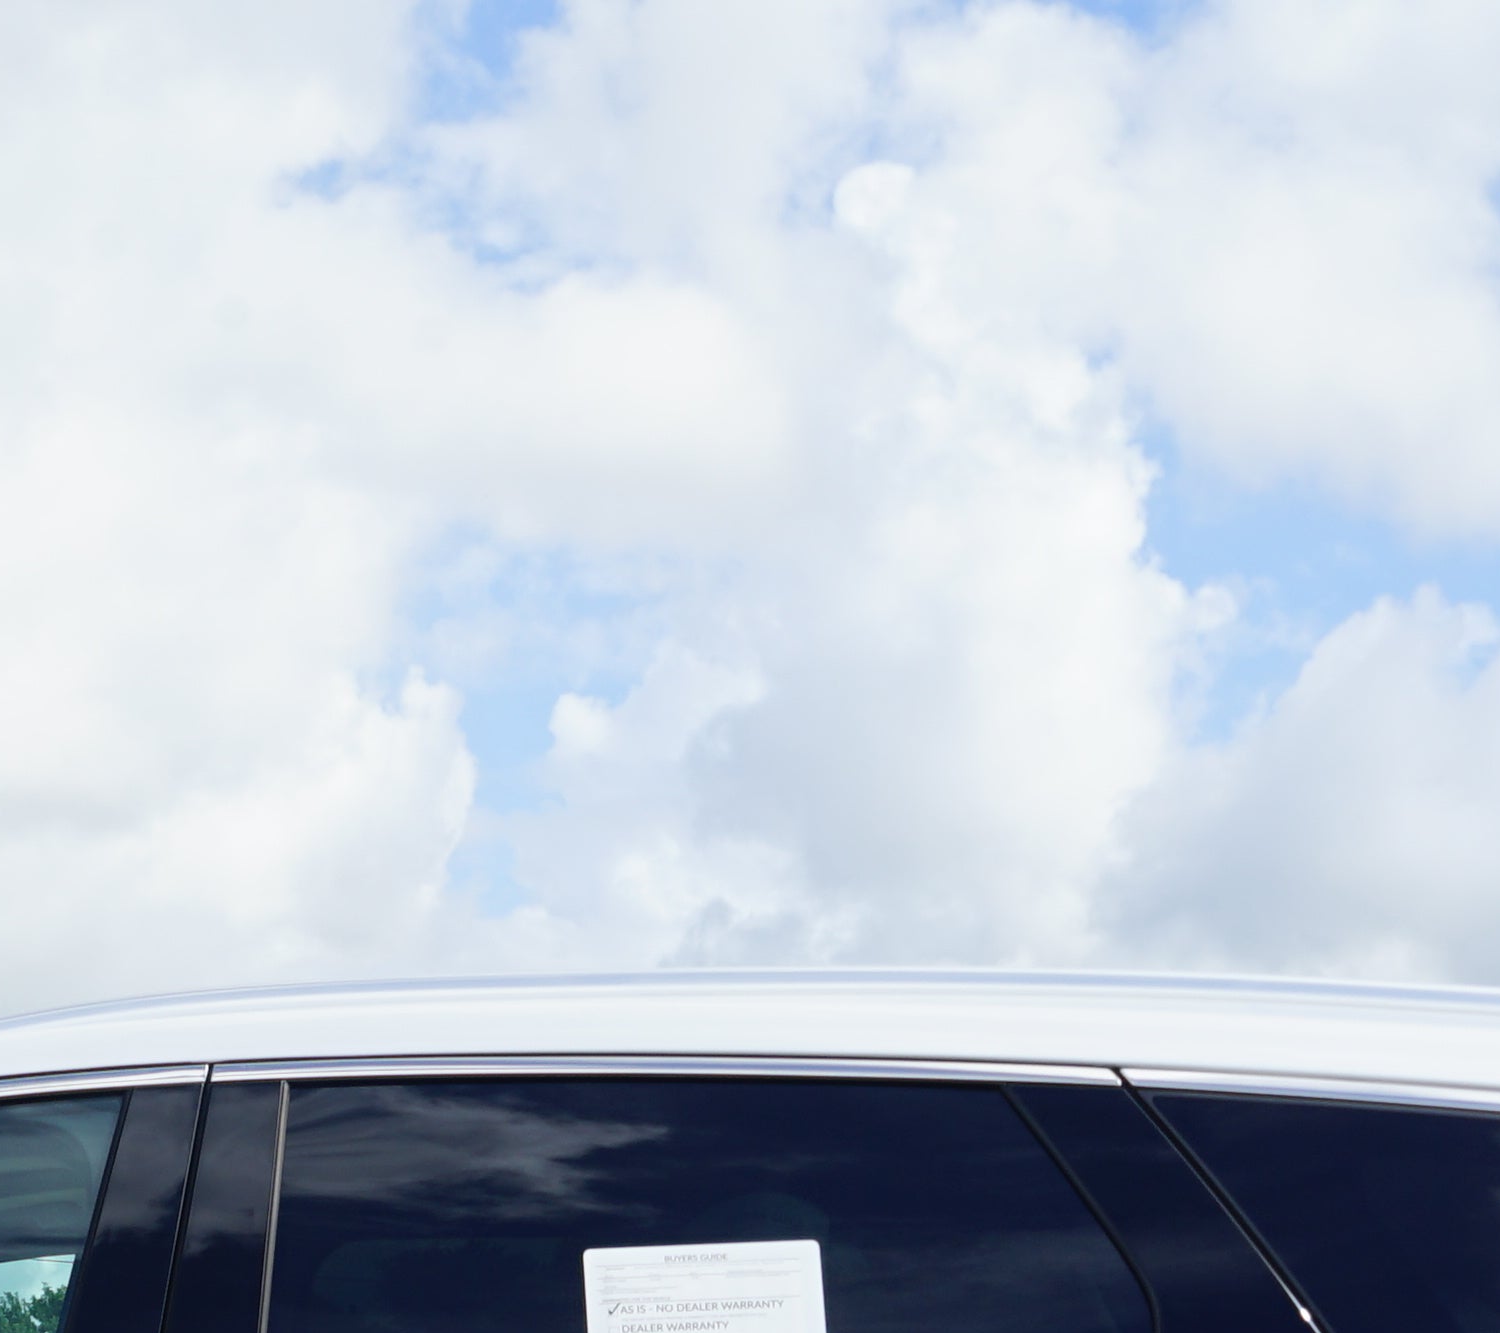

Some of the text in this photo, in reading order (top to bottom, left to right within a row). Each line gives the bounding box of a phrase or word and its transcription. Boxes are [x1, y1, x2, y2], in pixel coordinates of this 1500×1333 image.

[664, 1252, 728, 1264] BUYERS GUIDE
[620, 1304, 634, 1314] AS
[637, 1303, 646, 1313] IS
[656, 1302, 673, 1313] NO
[676, 1301, 718, 1312] DEALER
[721, 1299, 784, 1311] WARRANTY
[621, 1320, 729, 1333] DEALER WARRANTY
